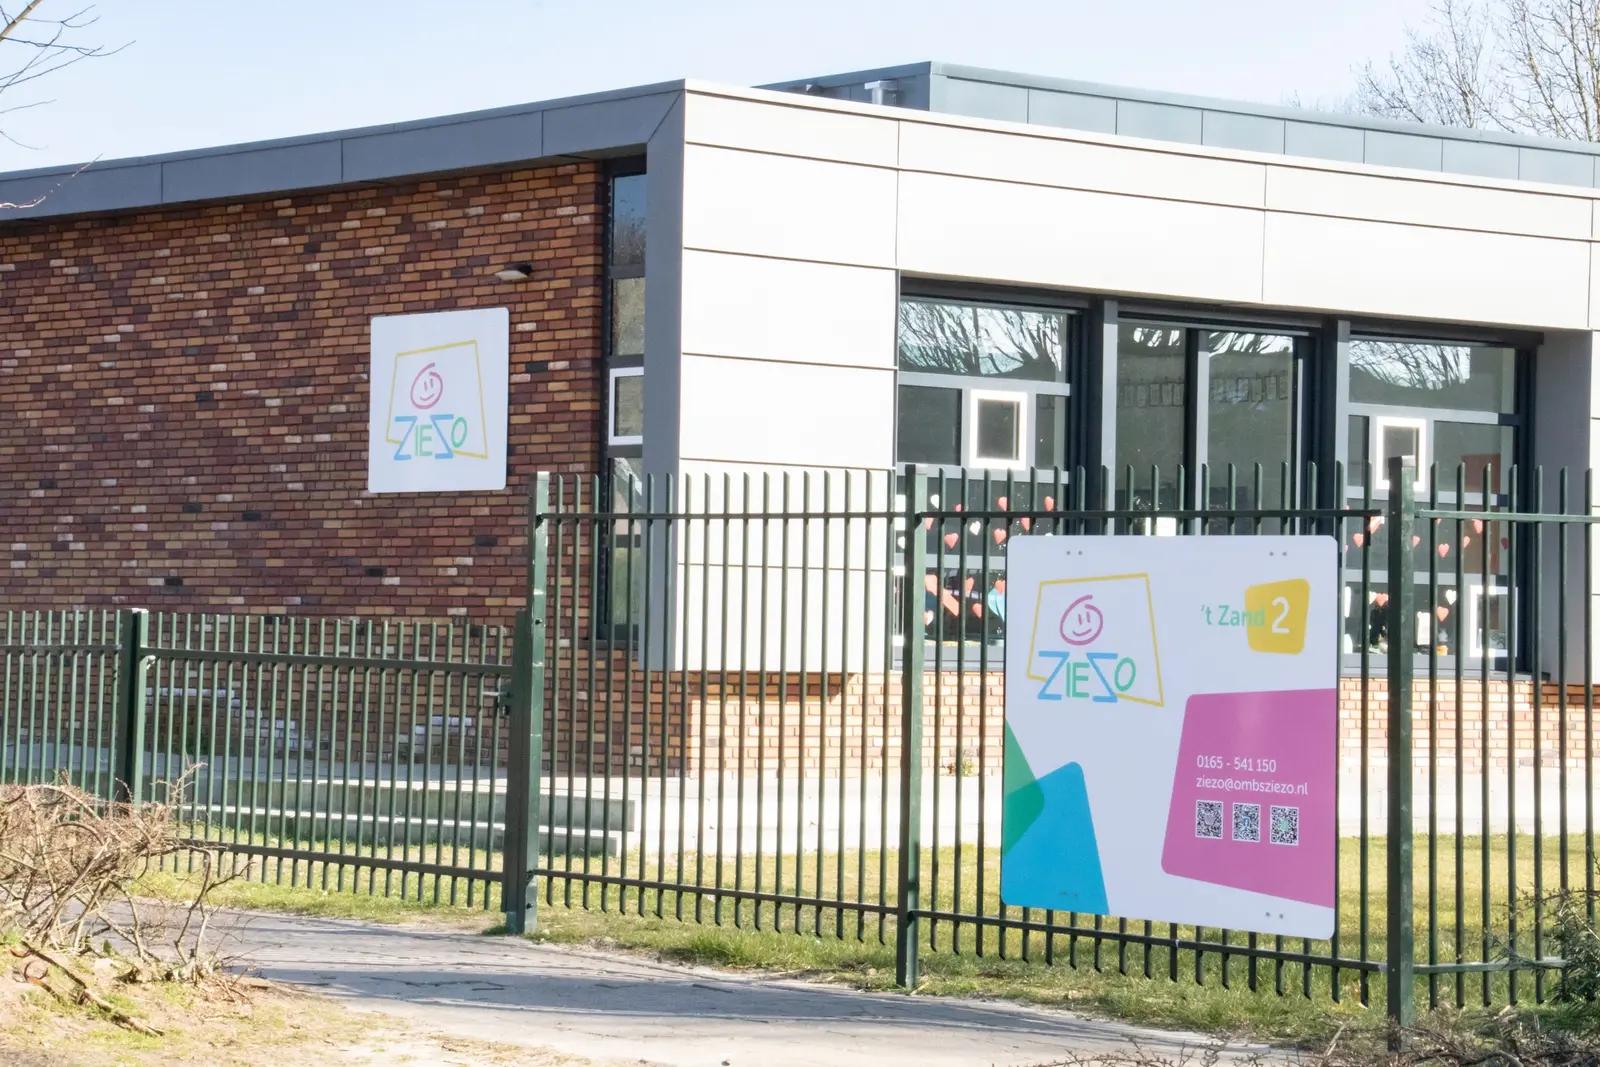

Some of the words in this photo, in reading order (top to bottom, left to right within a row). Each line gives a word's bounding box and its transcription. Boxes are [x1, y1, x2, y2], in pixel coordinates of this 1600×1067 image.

[1218, 605, 1265, 626] Zand
[1270, 596, 1291, 634] 2
[1196, 755, 1224, 769] 0165
[1233, 757, 1254, 772] 541
[1256, 758, 1277, 773] 150
[1196, 776, 1308, 796] ziezo@ombsziezo.nl
